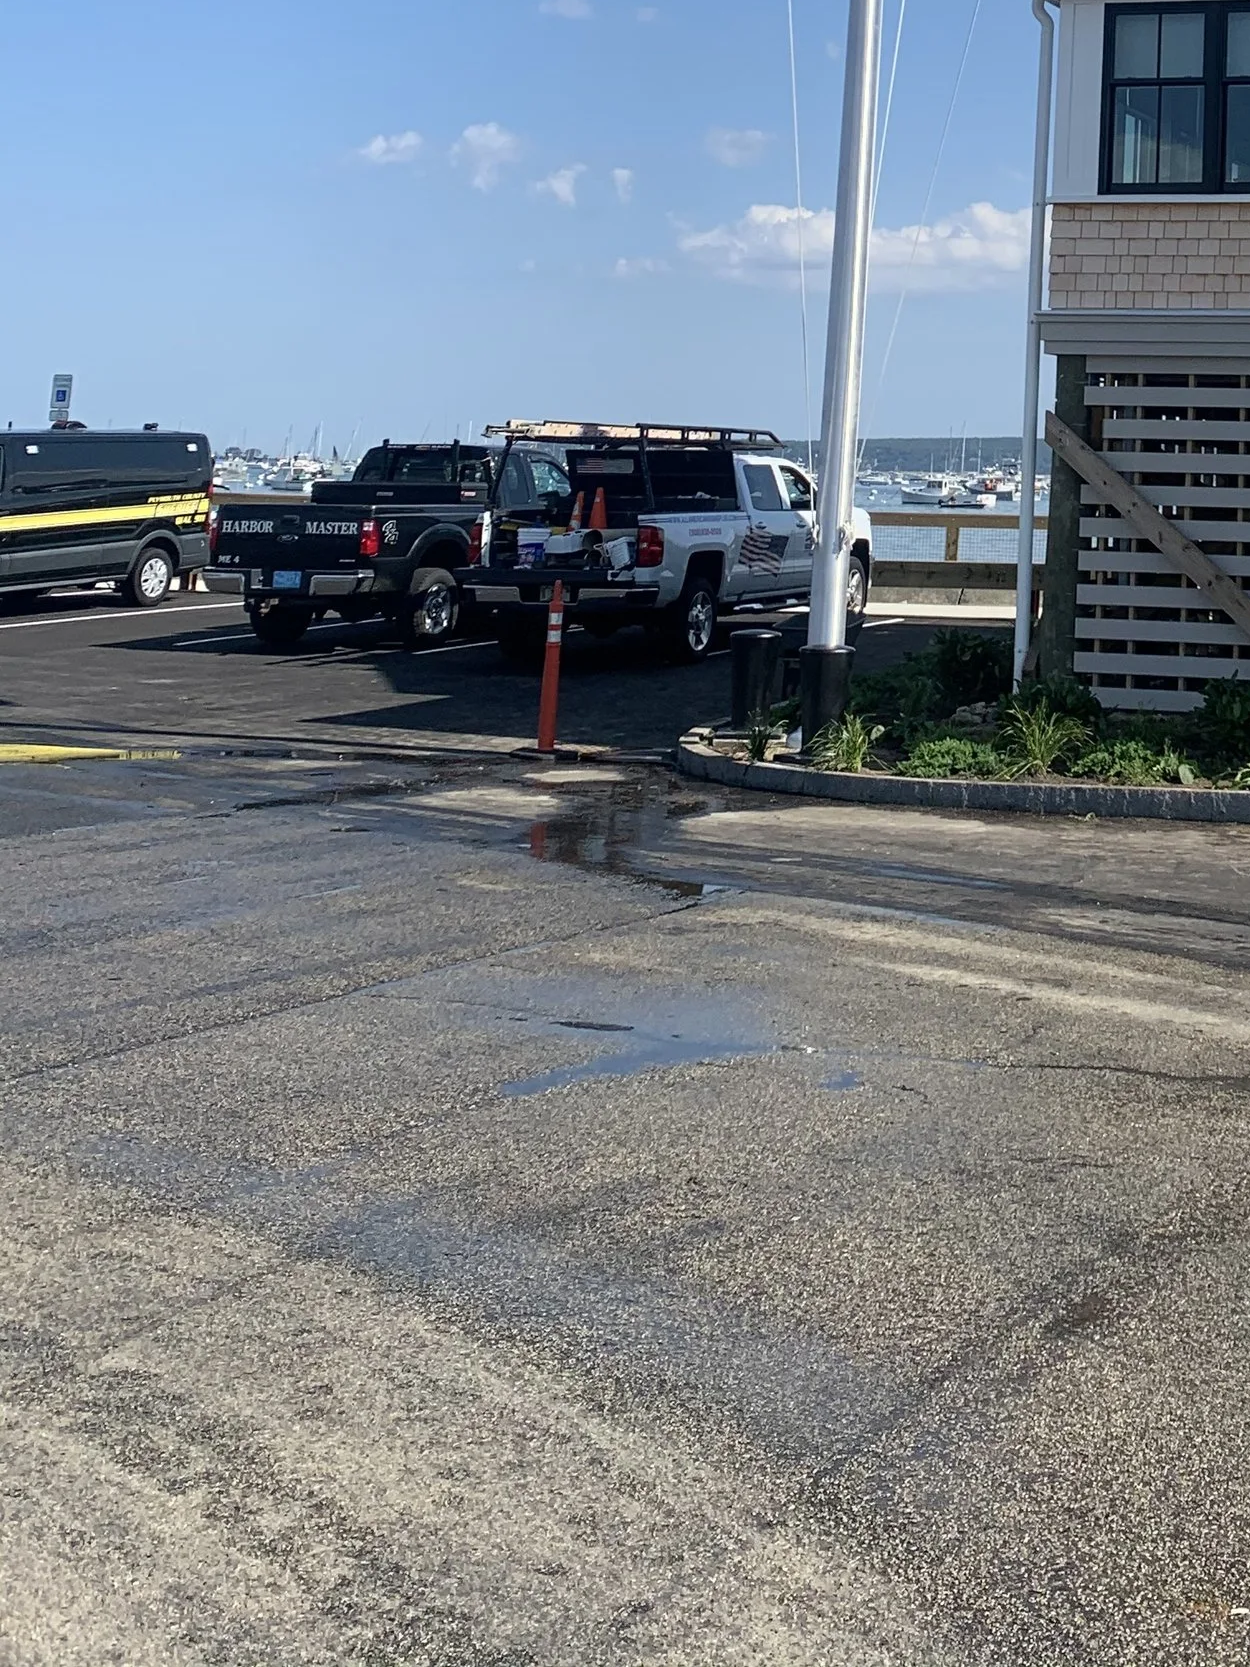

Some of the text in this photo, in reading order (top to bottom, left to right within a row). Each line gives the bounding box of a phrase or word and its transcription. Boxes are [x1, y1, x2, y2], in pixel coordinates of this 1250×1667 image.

[222, 520, 358, 534] HARBOR MASTER
[232, 555, 240, 563] 4
